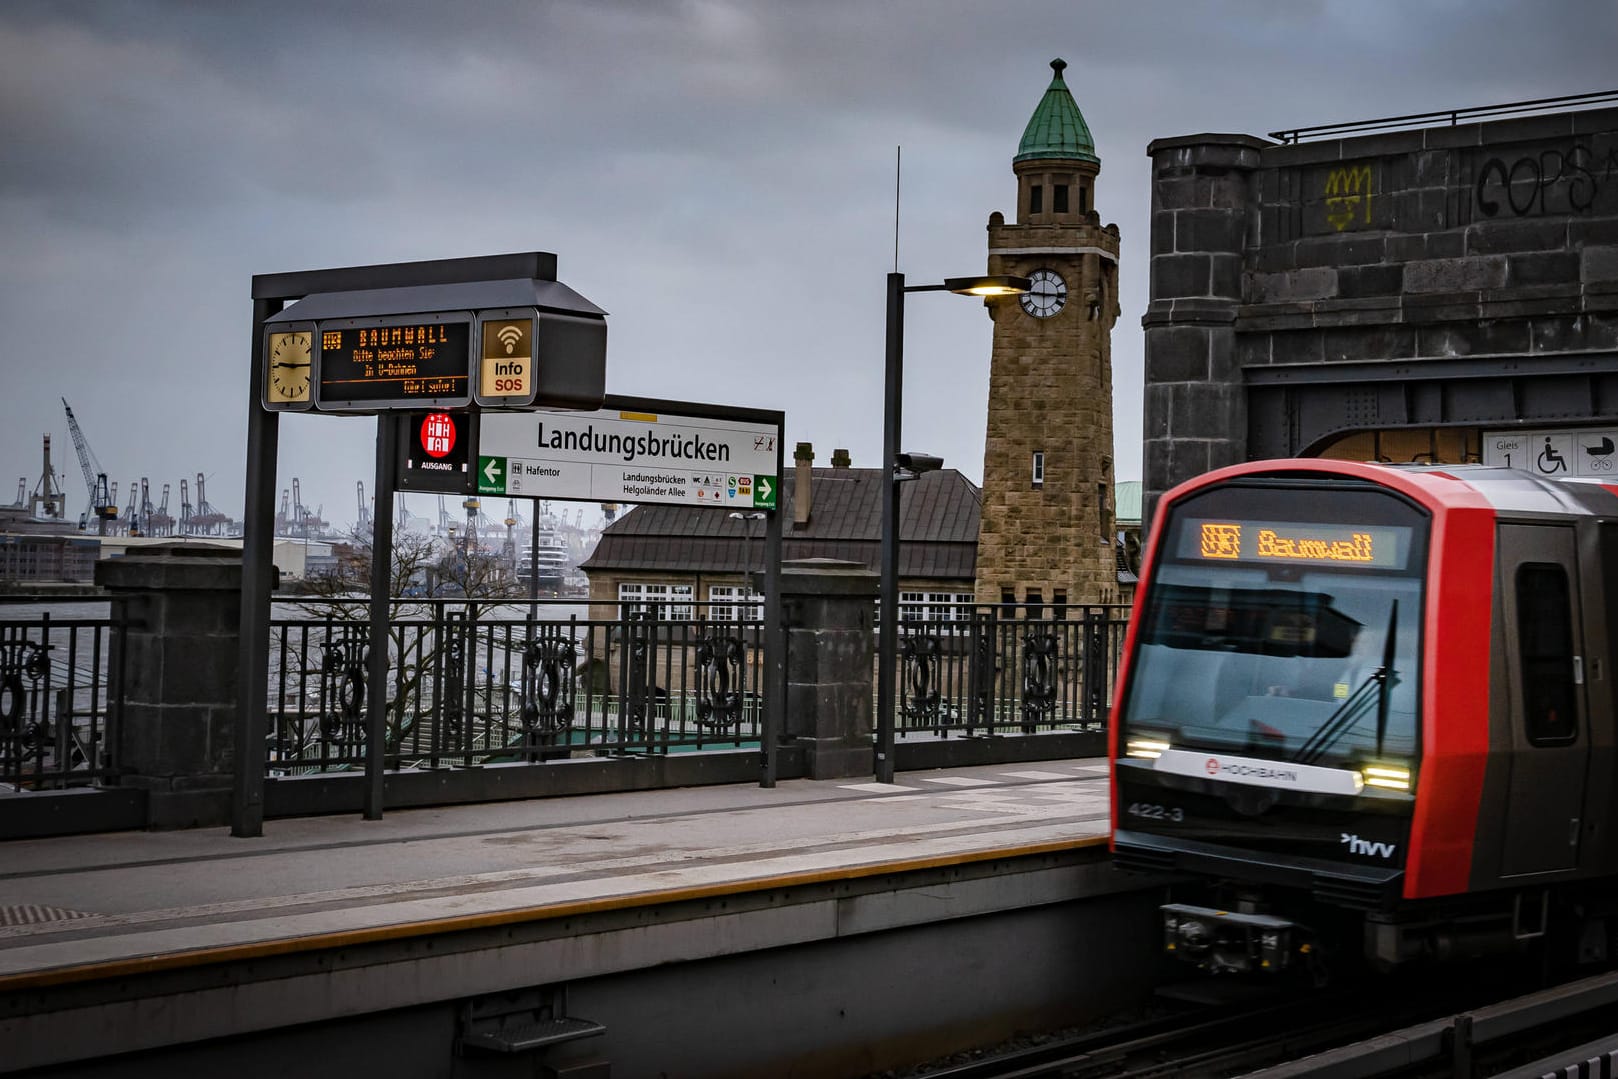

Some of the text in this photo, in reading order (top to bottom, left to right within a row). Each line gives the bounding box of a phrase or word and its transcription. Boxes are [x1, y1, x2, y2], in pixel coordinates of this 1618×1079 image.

[1477, 145, 1597, 216] COPS
[360, 325, 447, 347] BAUMWALL
[378, 348, 414, 361] beachten
[495, 362, 522, 375] Info
[495, 379, 522, 391] SOS
[537, 422, 730, 461] Landungsbrücken
[1497, 441, 1518, 450] Gleis
[421, 461, 452, 471] AUSGANG
[1504, 453, 1511, 467] 1
[526, 466, 560, 476] Hafentor
[622, 472, 686, 485] Landungsbrücken
[623, 485, 686, 497] Helgoländer Allee
[1222, 765, 1297, 782] HOCHBAHN
[1128, 803, 1184, 822] 422-3
